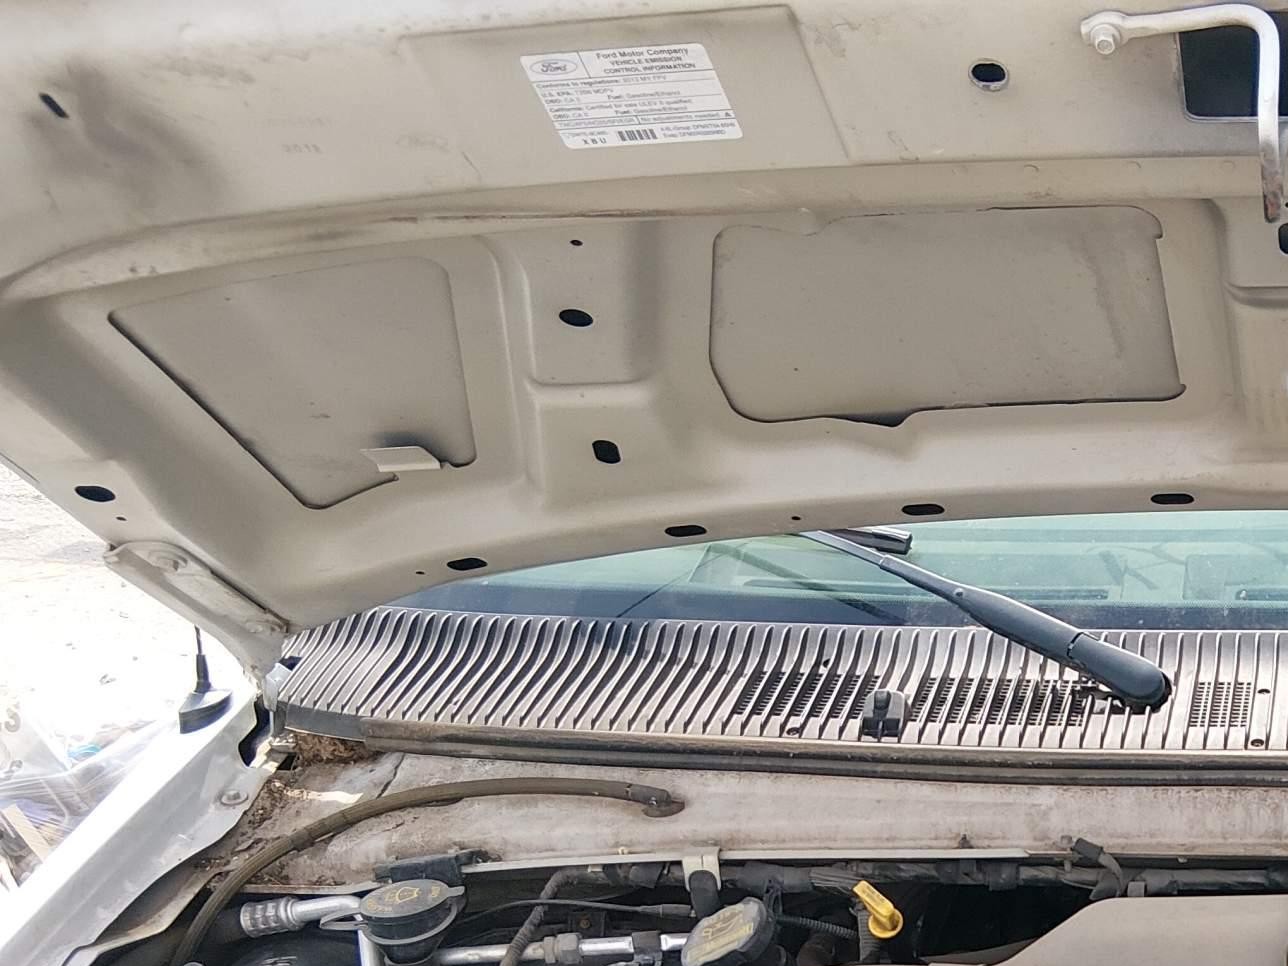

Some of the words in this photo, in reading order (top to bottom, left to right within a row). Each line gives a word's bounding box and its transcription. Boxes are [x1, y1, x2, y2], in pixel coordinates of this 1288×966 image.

[595, 52, 617, 60] Ford
[619, 50, 645, 58] Motor
[646, 47, 689, 57] Company
[609, 59, 644, 67] VEHICLE
[646, 56, 683, 64] EMISSION
[540, 62, 568, 73] Ford
[603, 67, 641, 75] CONTROL
[643, 63, 696, 71] INFORMATION
